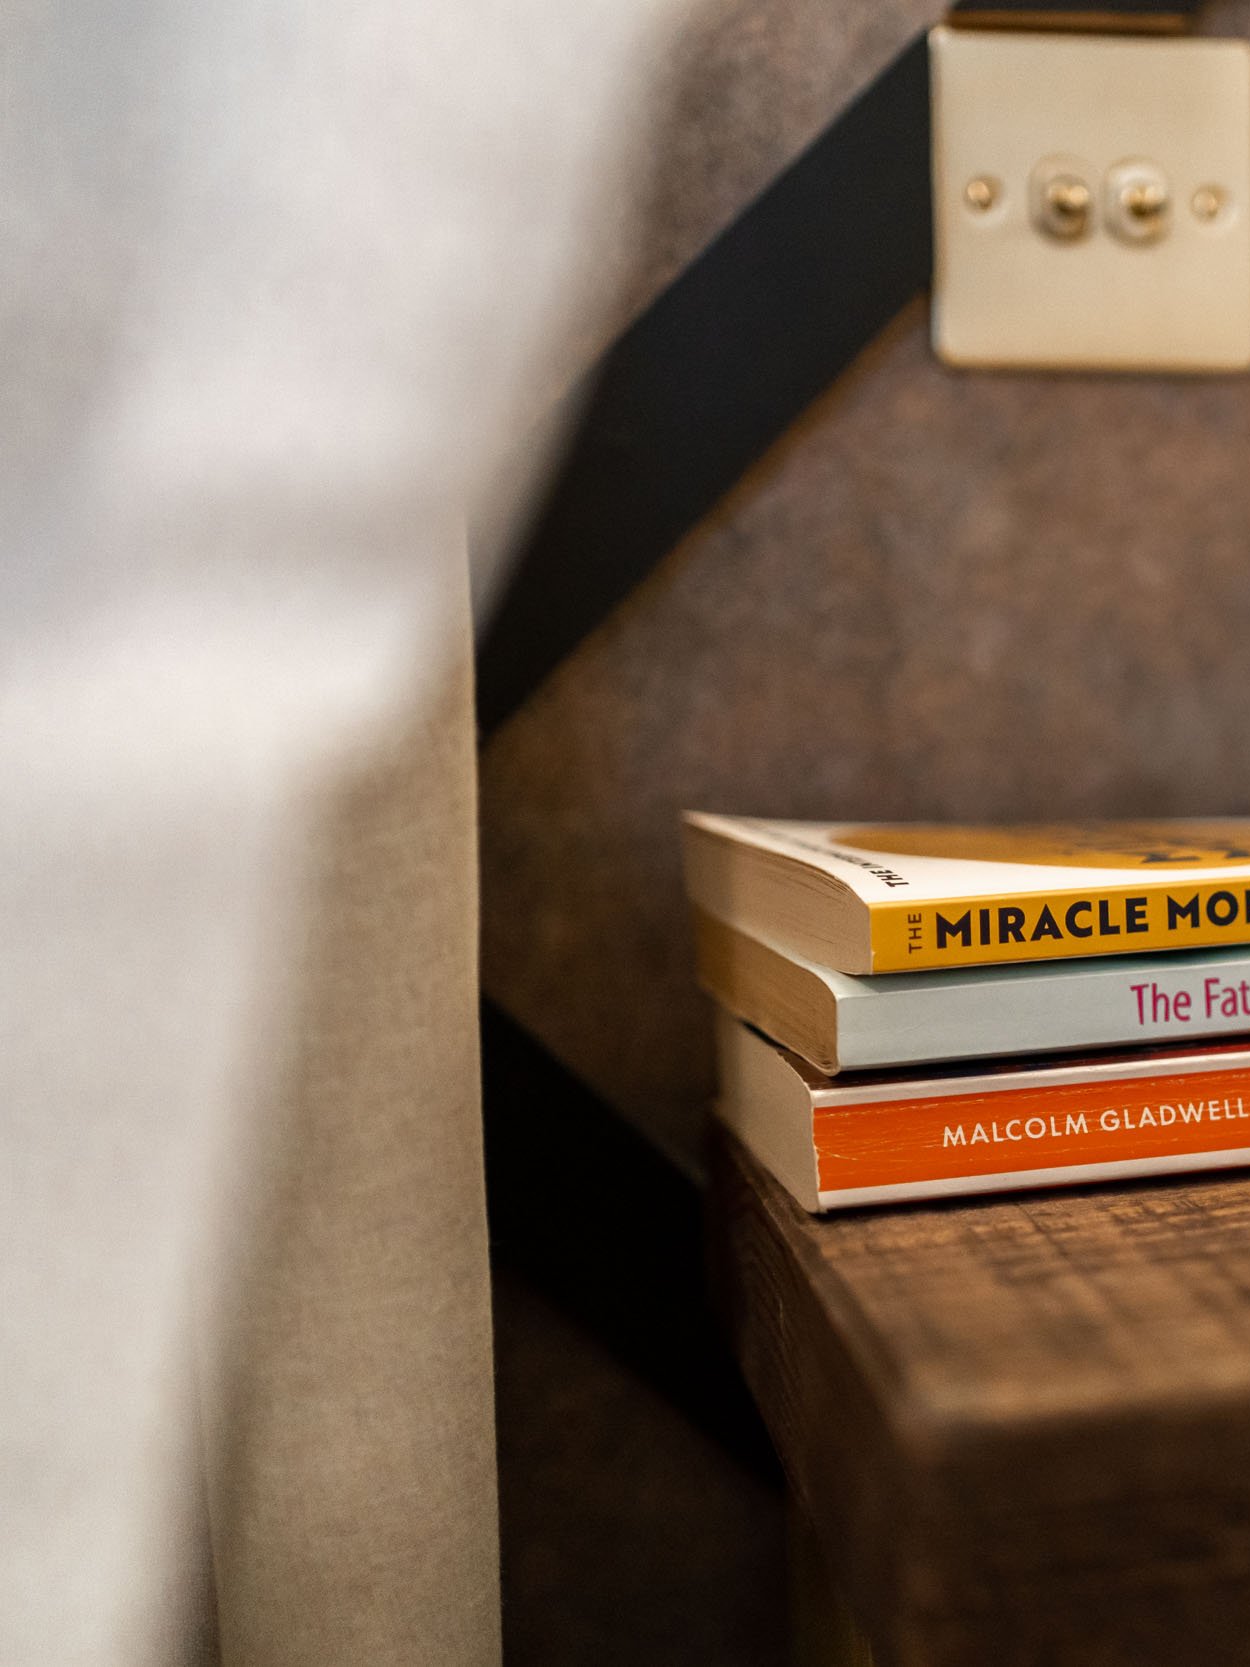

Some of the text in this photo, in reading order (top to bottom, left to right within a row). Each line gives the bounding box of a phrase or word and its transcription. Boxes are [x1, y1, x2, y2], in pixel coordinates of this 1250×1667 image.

[869, 867, 909, 888] THE
[907, 912, 922, 954] THE
[936, 897, 1149, 949] MIRACLE
[1130, 983, 1193, 1026] The
[943, 1113, 1089, 1148] MALCOLM
[1100, 1097, 1249, 1132] GLADWELL
